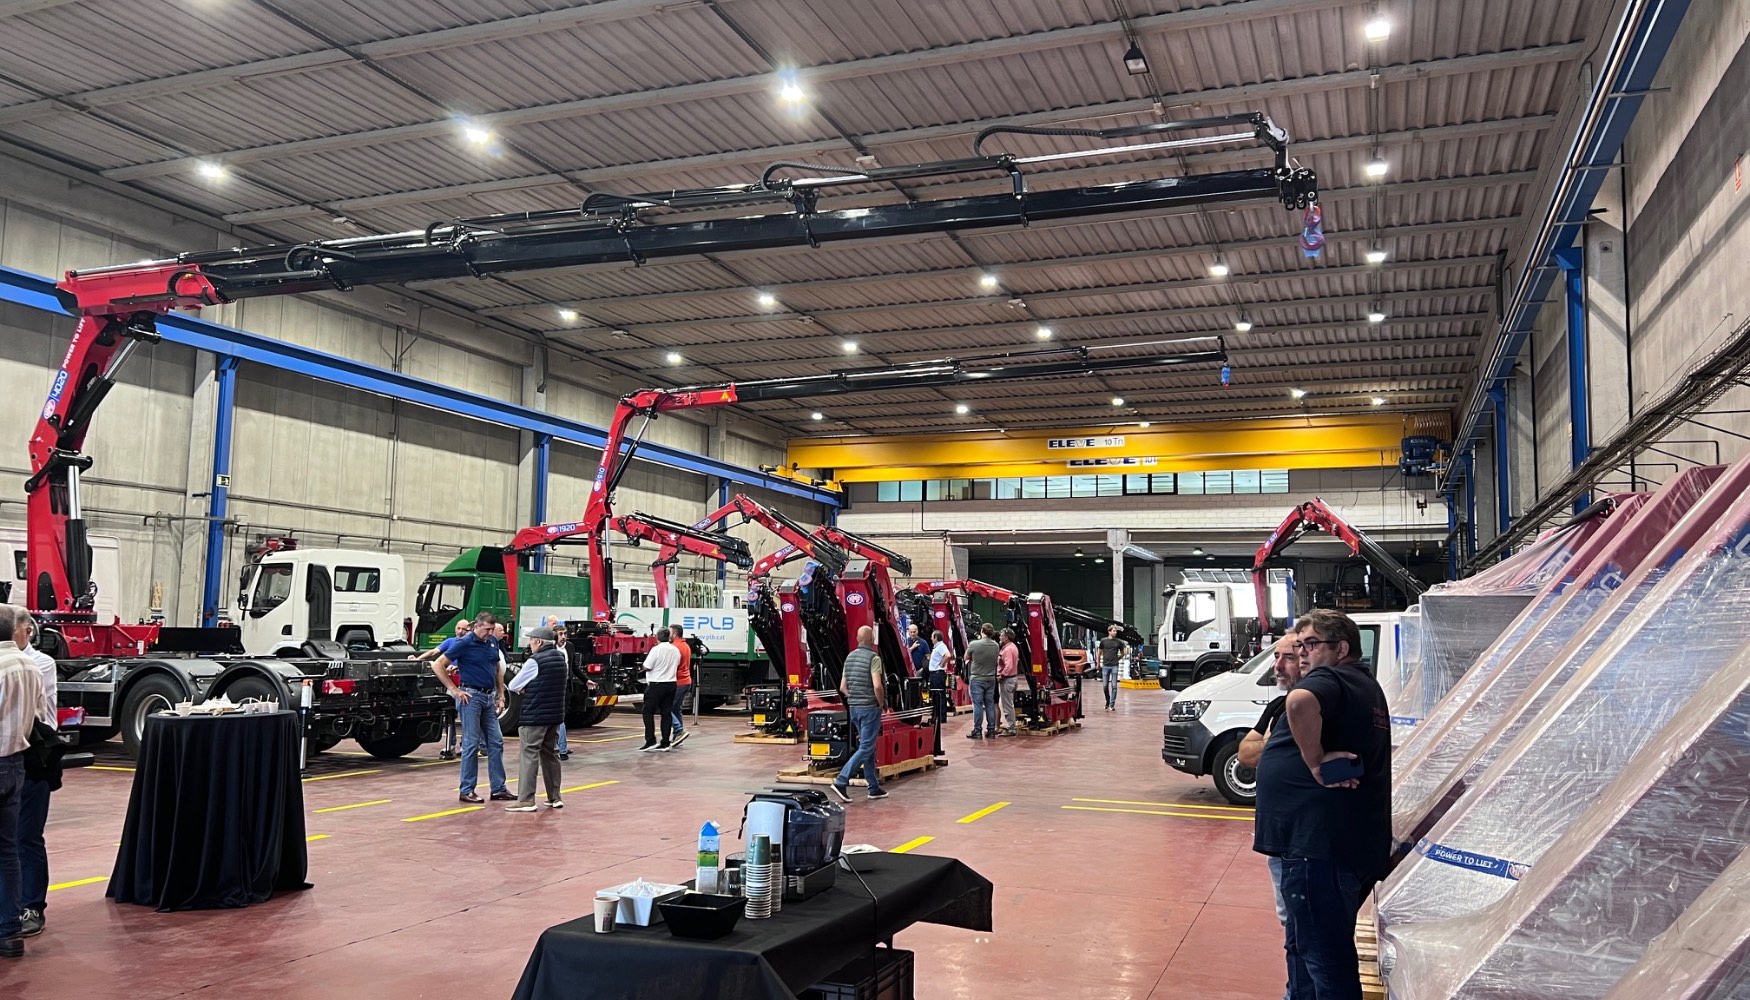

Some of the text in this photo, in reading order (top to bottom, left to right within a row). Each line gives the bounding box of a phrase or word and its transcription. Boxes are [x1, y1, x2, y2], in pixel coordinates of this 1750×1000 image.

[52, 370, 68, 398] 4020
[62, 344, 75, 368] POWER
[72, 333, 80, 343] TO
[77, 318, 86, 333] LIFT
[1048, 438, 1096, 448] ELEVE
[1104, 438, 1112, 446] 10
[1069, 457, 1136, 466] ELEVE
[1435, 848, 1462, 863] POWER
[1464, 855, 1475, 866] TO
